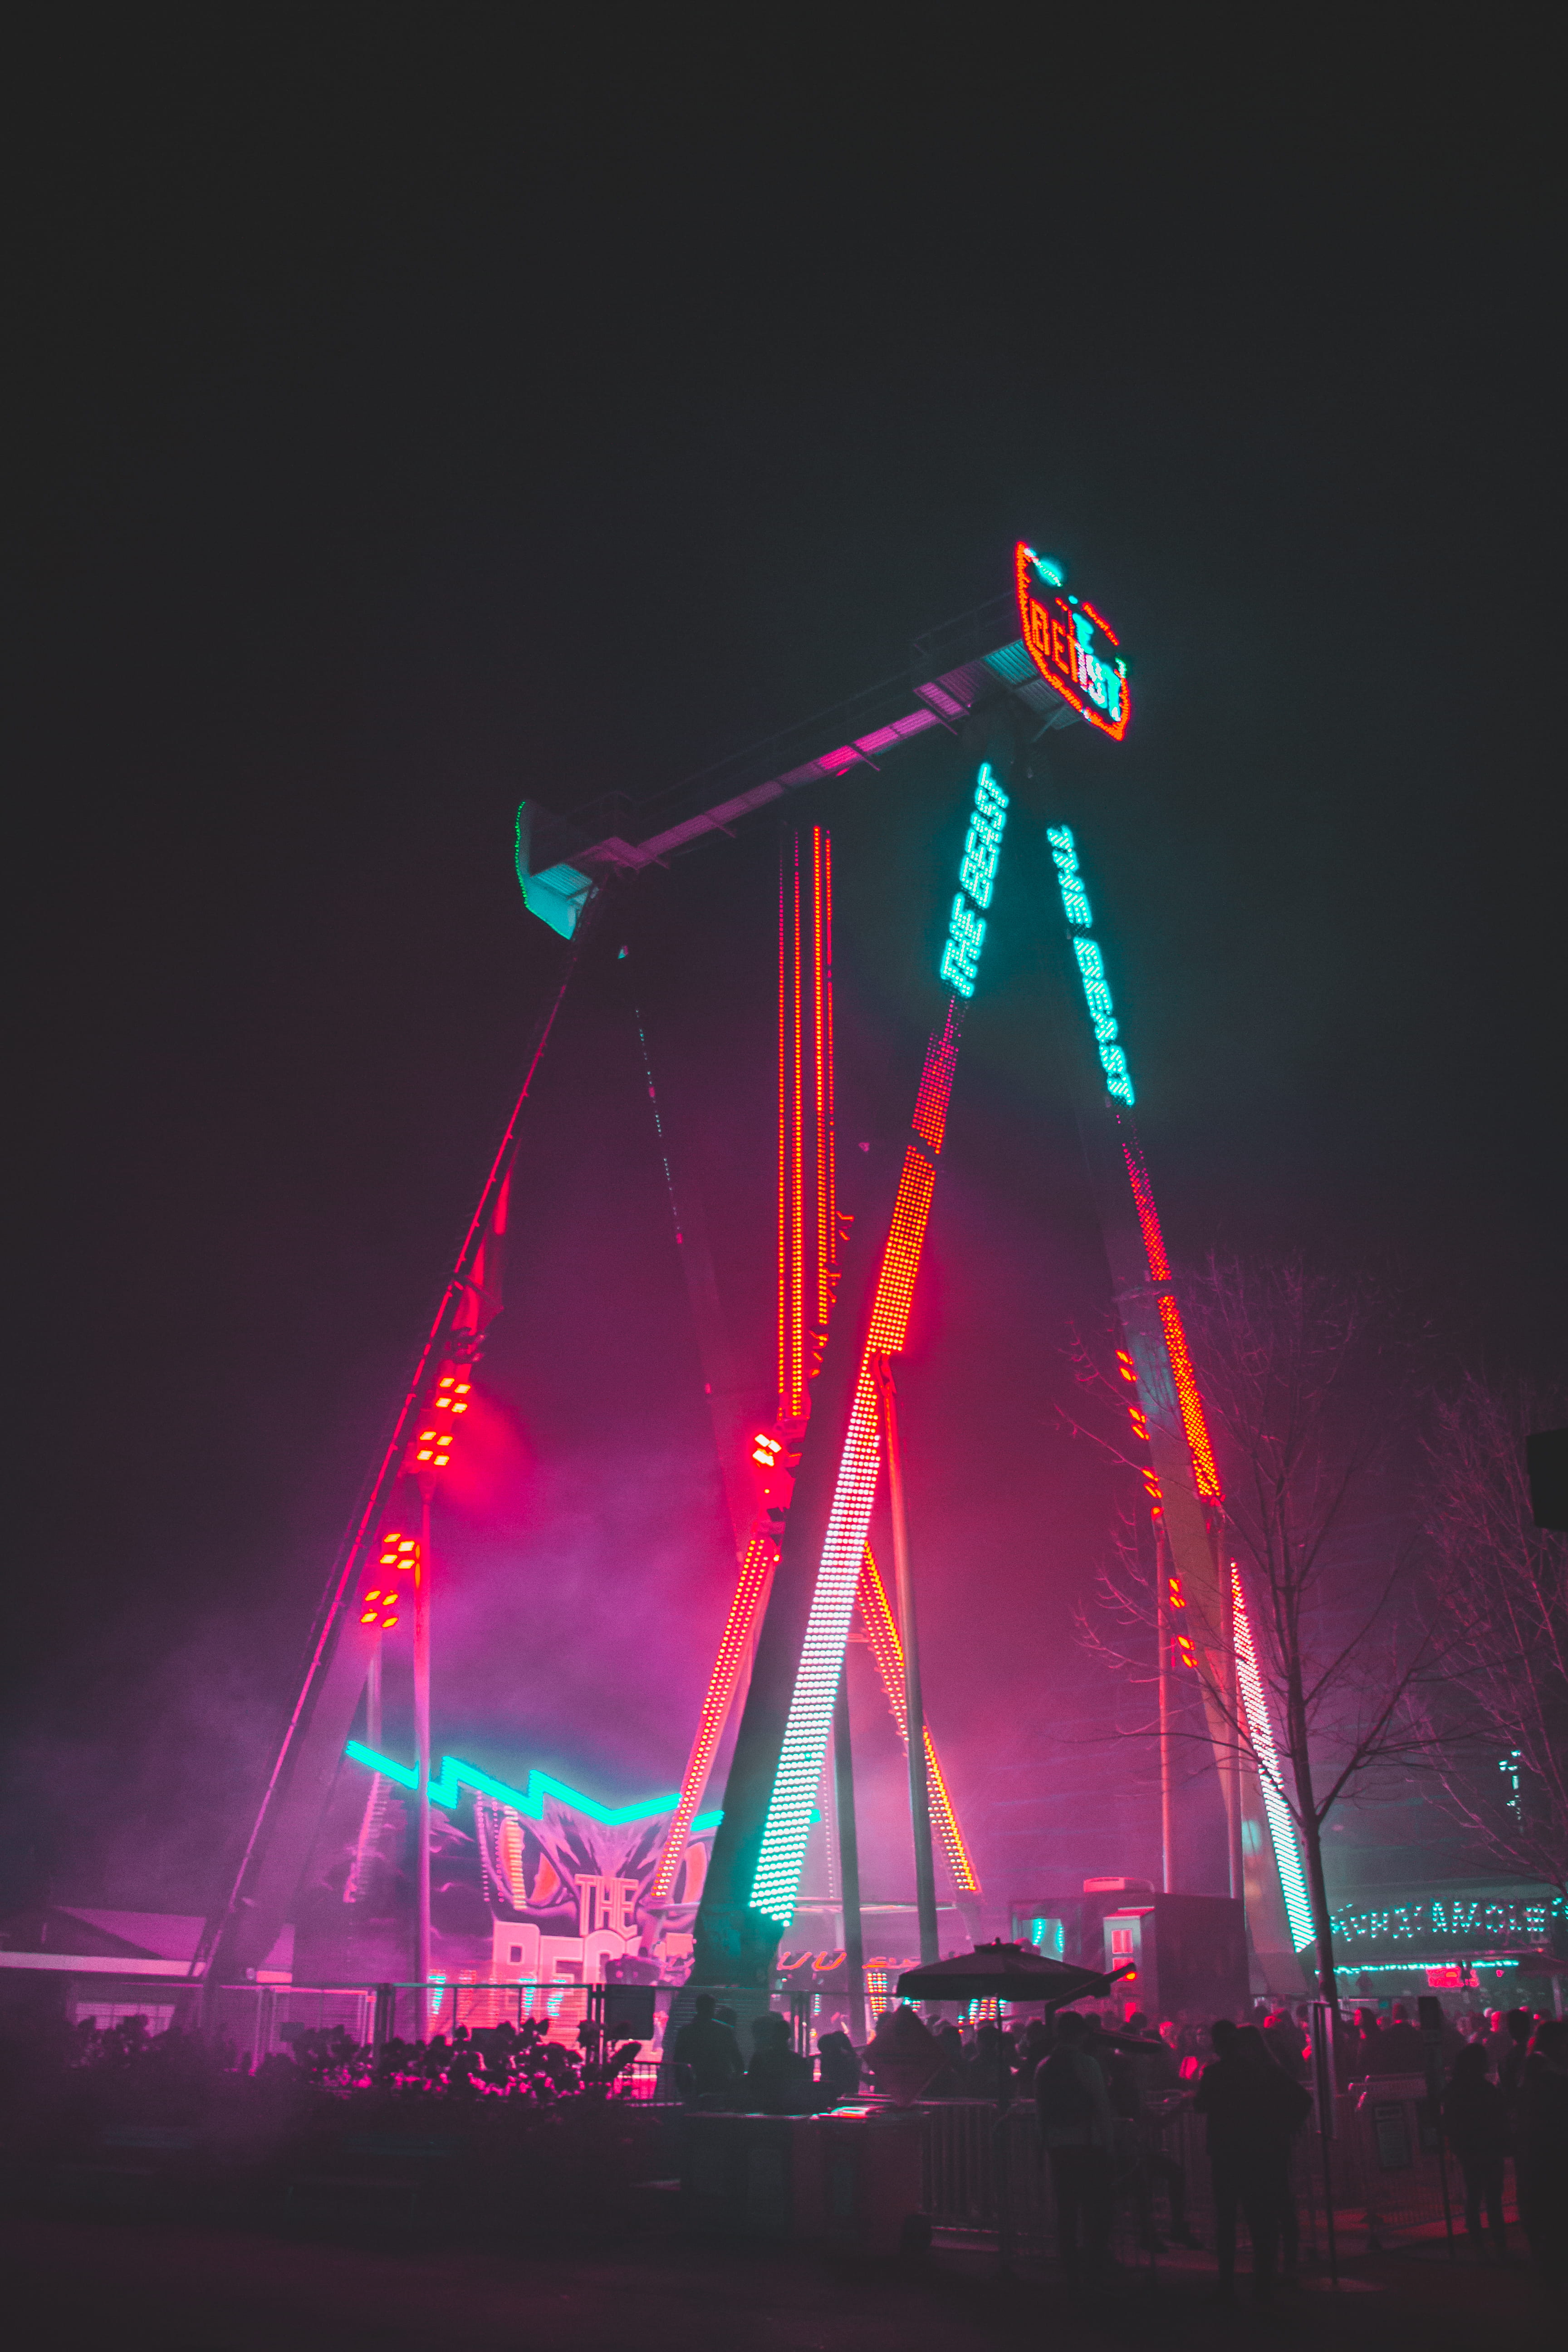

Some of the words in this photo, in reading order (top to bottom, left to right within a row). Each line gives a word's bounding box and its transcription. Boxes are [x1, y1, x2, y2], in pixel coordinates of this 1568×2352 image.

[1029, 598, 1122, 722] BEAST
[959, 762, 1009, 909] BEAST
[941, 892, 986, 997] THE
[574, 1873, 639, 1940] THE
